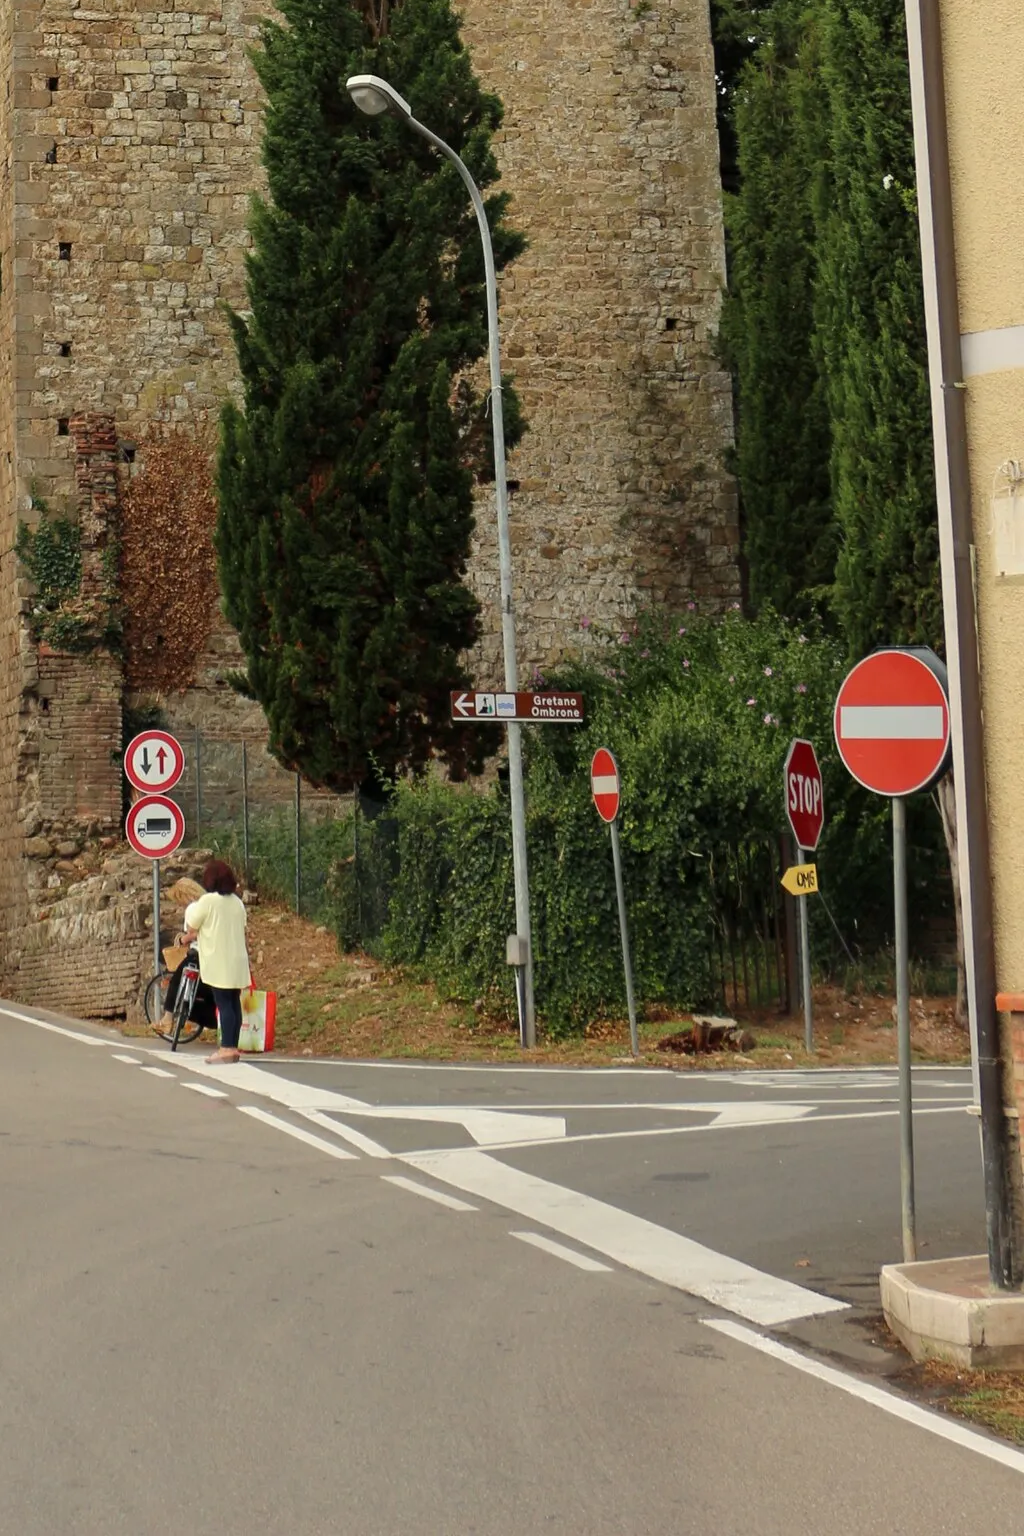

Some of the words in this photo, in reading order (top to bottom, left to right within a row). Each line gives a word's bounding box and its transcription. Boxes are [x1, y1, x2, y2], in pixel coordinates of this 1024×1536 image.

[533, 695, 577, 706] Gretano
[531, 706, 580, 718] Ombrone
[789, 772, 820, 816] STOP
[796, 871, 815, 889] OMG
